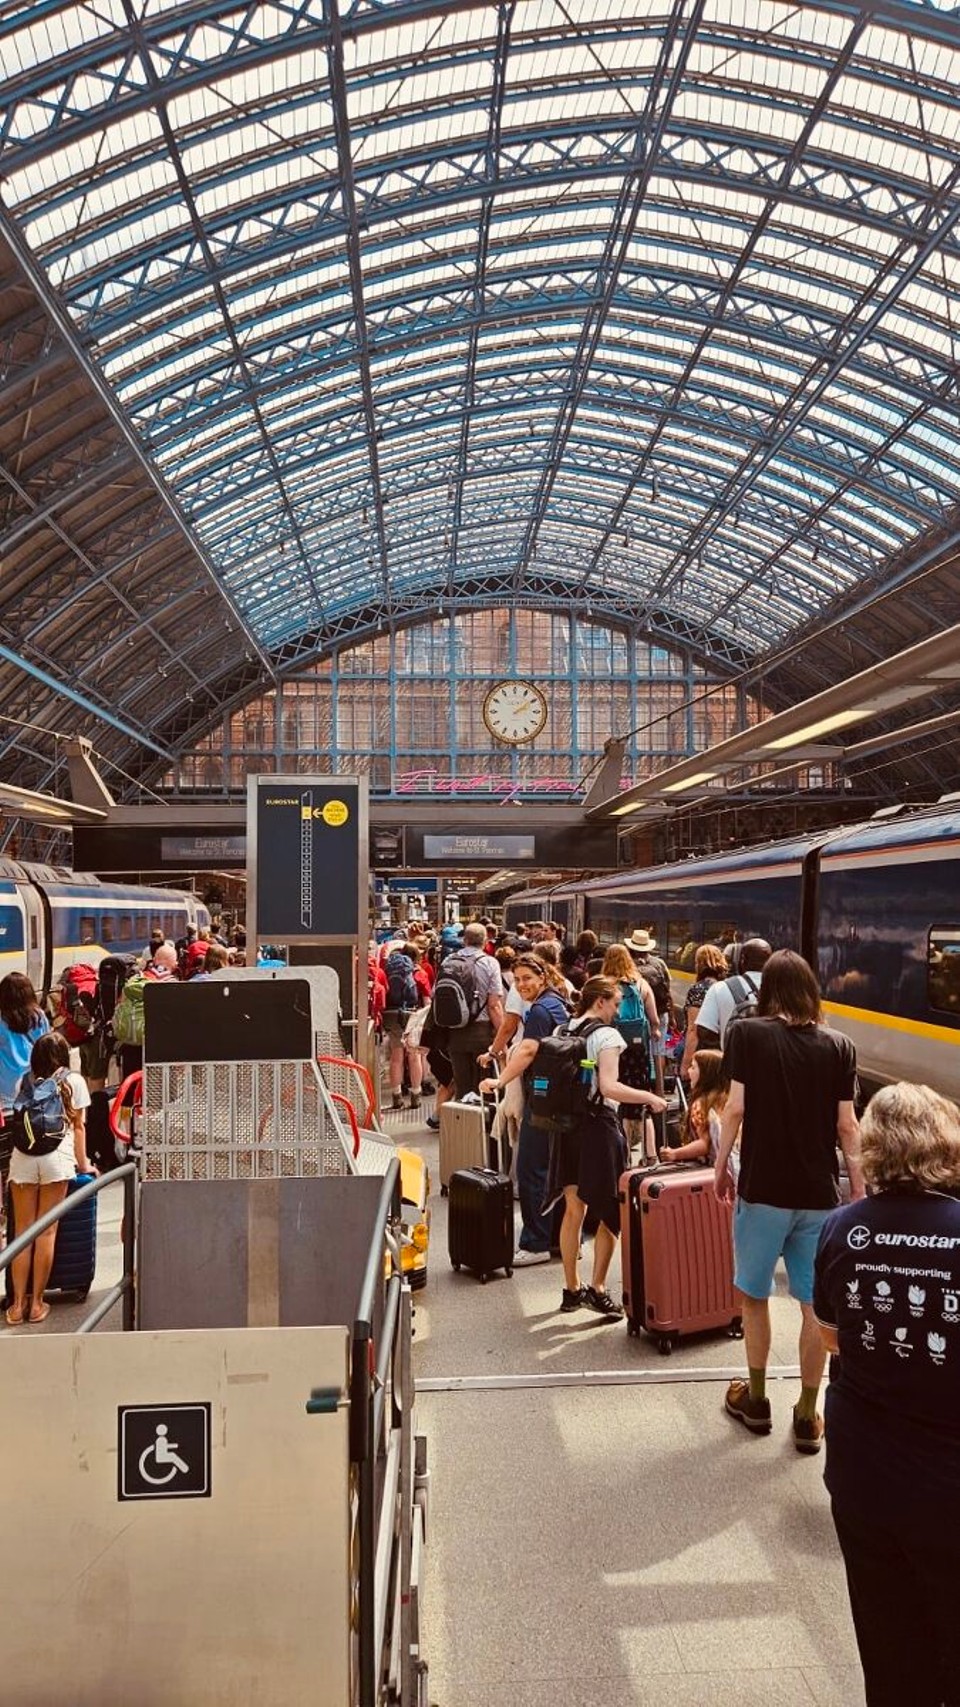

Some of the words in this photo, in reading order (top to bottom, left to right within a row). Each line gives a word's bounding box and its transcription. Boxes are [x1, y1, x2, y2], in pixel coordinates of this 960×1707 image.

[194, 837, 229, 848] Eurostar
[455, 836, 489, 846] Eurostar
[874, 1233, 960, 1249] eurostar
[855, 1263, 892, 1273] proudly
[893, 1266, 951, 1280] supporting
[944, 1294, 958, 1313] D
